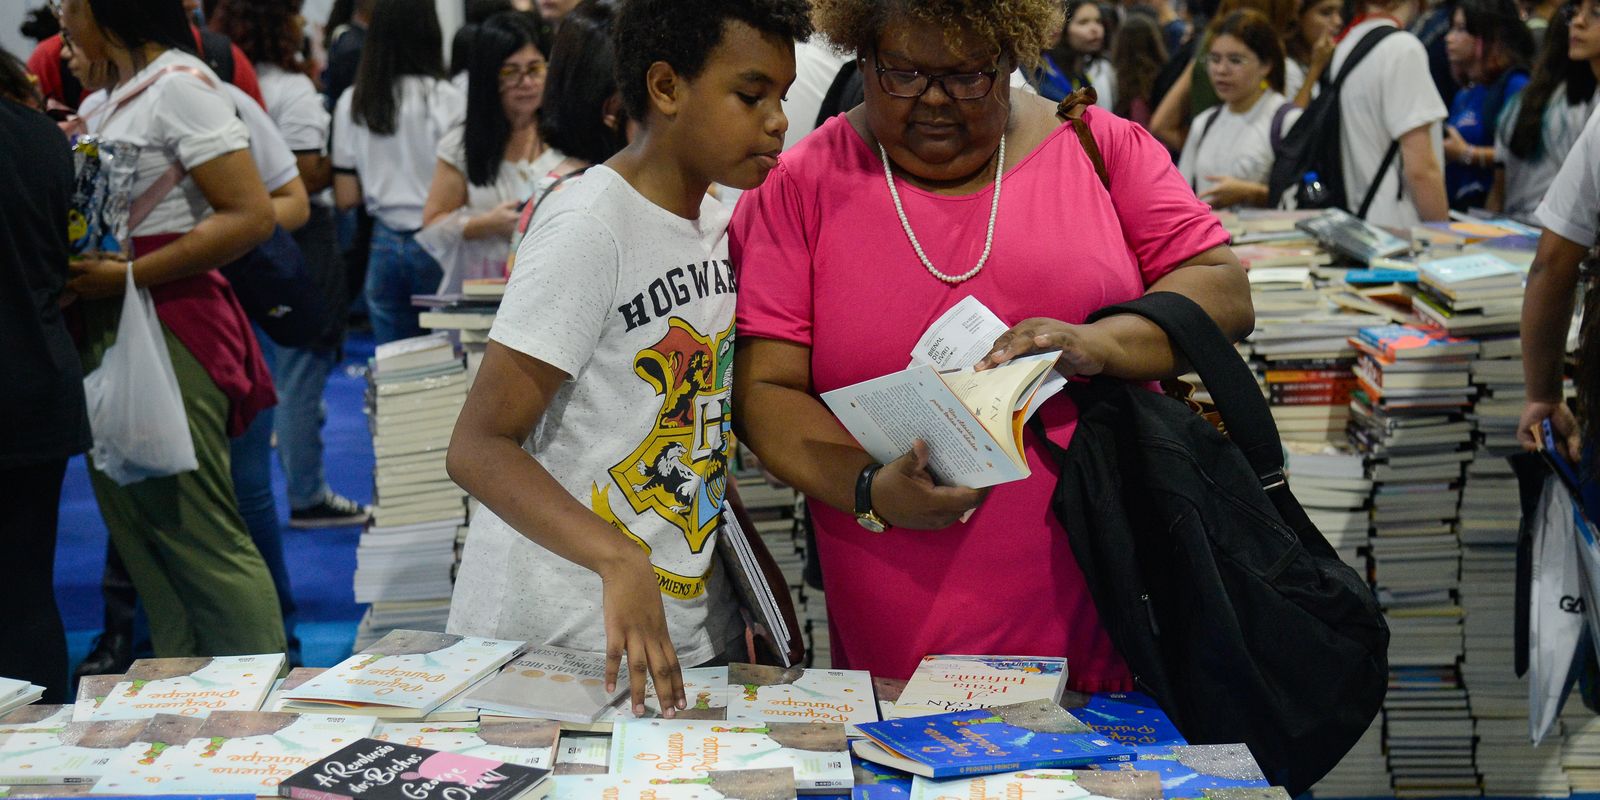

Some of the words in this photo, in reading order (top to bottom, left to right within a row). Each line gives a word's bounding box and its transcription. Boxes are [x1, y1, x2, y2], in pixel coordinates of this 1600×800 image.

[618, 259, 737, 333] HOGWAR
[928, 337, 945, 357] BIENAL
[369, 668, 446, 684] Príncipe
[347, 678, 424, 693] Pequeno
[147, 689, 240, 701] Príncipe
[134, 700, 228, 711] Pequeno
[769, 698, 854, 713] Príncipe
[762, 709, 849, 723] Pequeno
[226, 751, 324, 767] ríncipe
[633, 752, 661, 761] O
[656, 731, 697, 771] Pequeno
[691, 735, 730, 773] Príncipe
[208, 762, 295, 777] equeno
[323, 744, 395, 779] Revolução
[313, 772, 340, 789] A
[349, 776, 375, 794] dos
[363, 753, 423, 786] Bichos
[401, 766, 467, 800] George
[442, 767, 511, 800] Orwell
